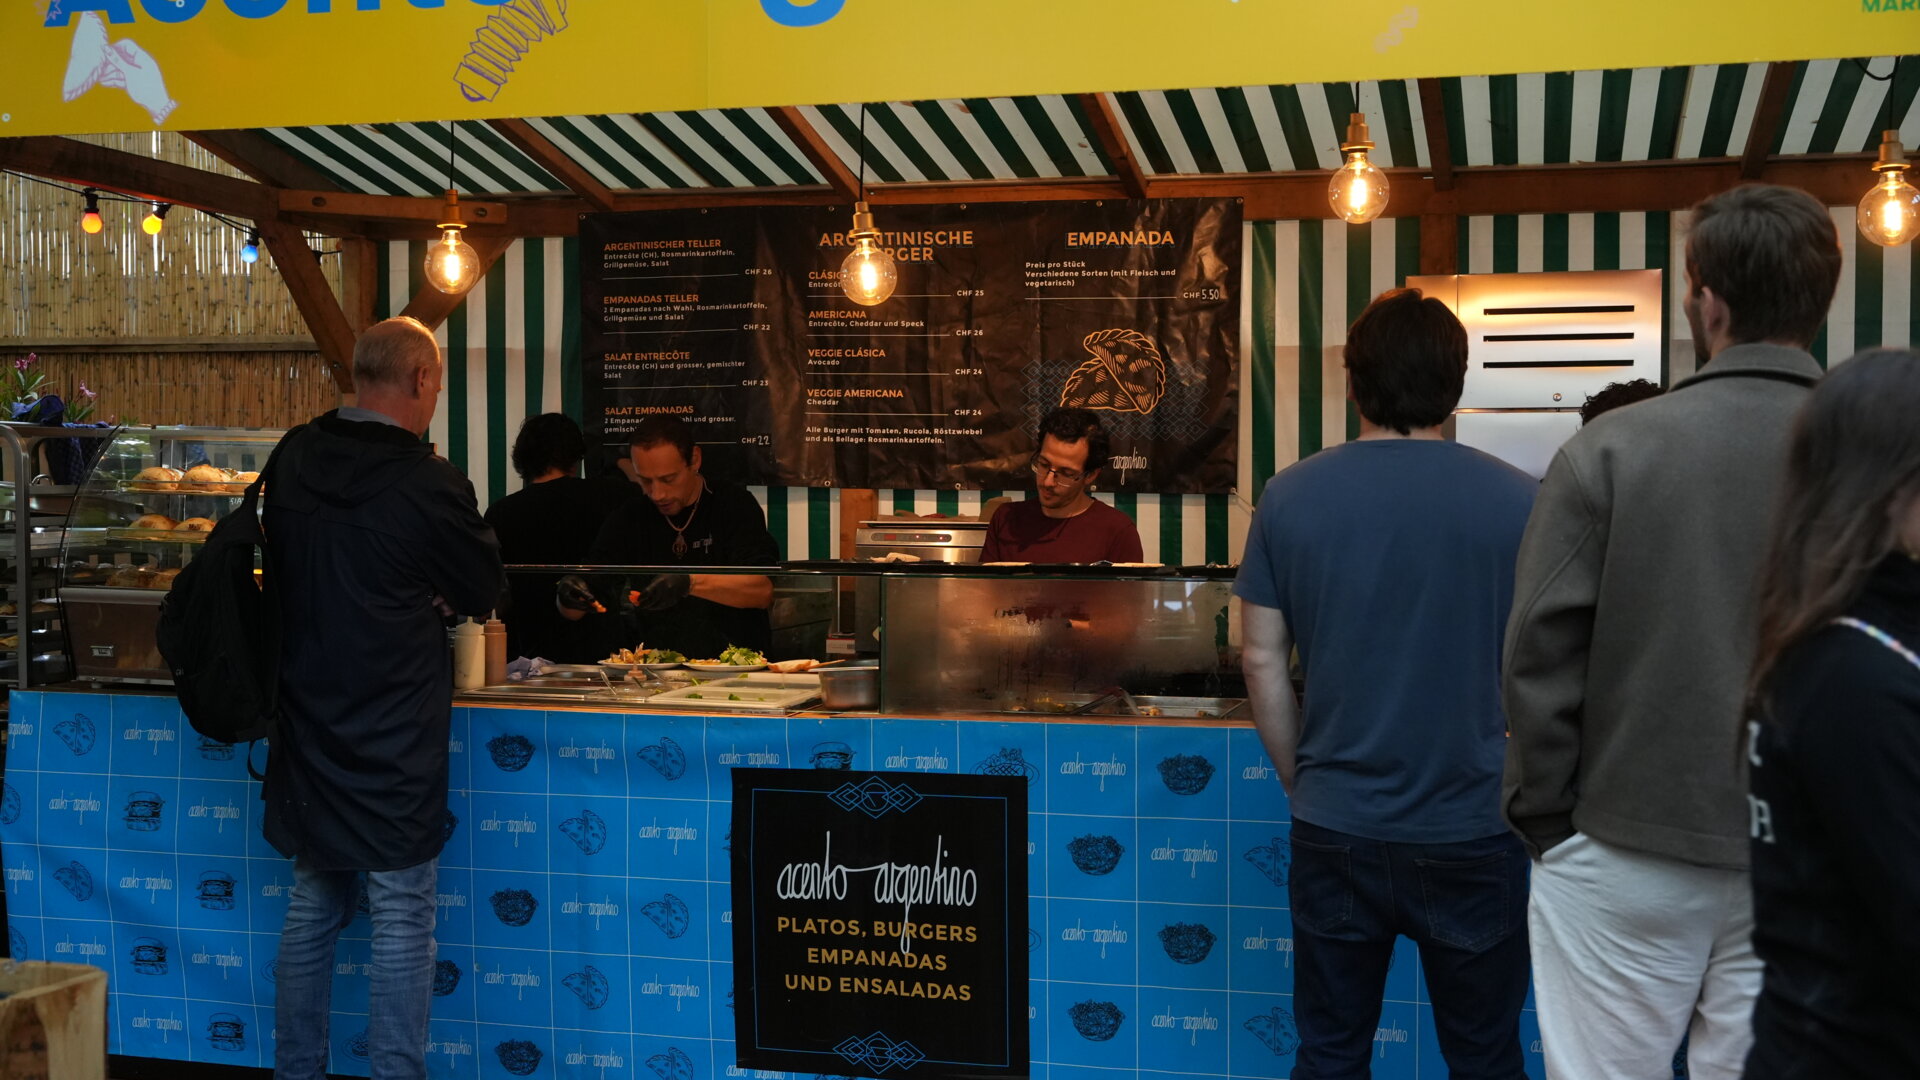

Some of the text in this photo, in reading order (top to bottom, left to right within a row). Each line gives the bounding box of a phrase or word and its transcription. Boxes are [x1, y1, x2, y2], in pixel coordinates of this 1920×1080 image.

[820, 230, 973, 246] ARGNTINISCHE
[1067, 231, 1174, 246] EMPANADA
[604, 239, 721, 251] ARGENTINISCHER TELLER
[604, 252, 640, 260] Entrecôte
[1063, 260, 1085, 268] Stück
[1025, 279, 1075, 288] vegetarisch)
[604, 294, 699, 304] EMPANADAS TELLER
[1202, 289, 1219, 301] 5.50
[610, 305, 651, 314] Empanadas
[674, 304, 695, 312] Wahl,
[604, 314, 647, 322] Grillgemüse
[808, 311, 867, 319] AMERICANA
[901, 320, 924, 328] Speck
[605, 350, 690, 361] SALAT ENTRECÔTE
[808, 347, 885, 357] VEGGIE CLÁSICA
[604, 362, 640, 370] Entrecôte
[707, 360, 745, 369] gemischter
[807, 389, 903, 398] VEGGIE AMERICANA
[605, 405, 694, 415] SALAT EMPANADAS
[824, 427, 849, 435] Burger
[934, 428, 983, 436] Röstzwiebel
[758, 435, 770, 446] 22
[836, 436, 866, 444] Beilage:
[776, 830, 977, 955] acento argentino
[777, 916, 977, 942] PLATOS, BURGERS
[807, 948, 947, 971] EMPANADAS
[785, 974, 971, 1001] UND ENSALADAS
